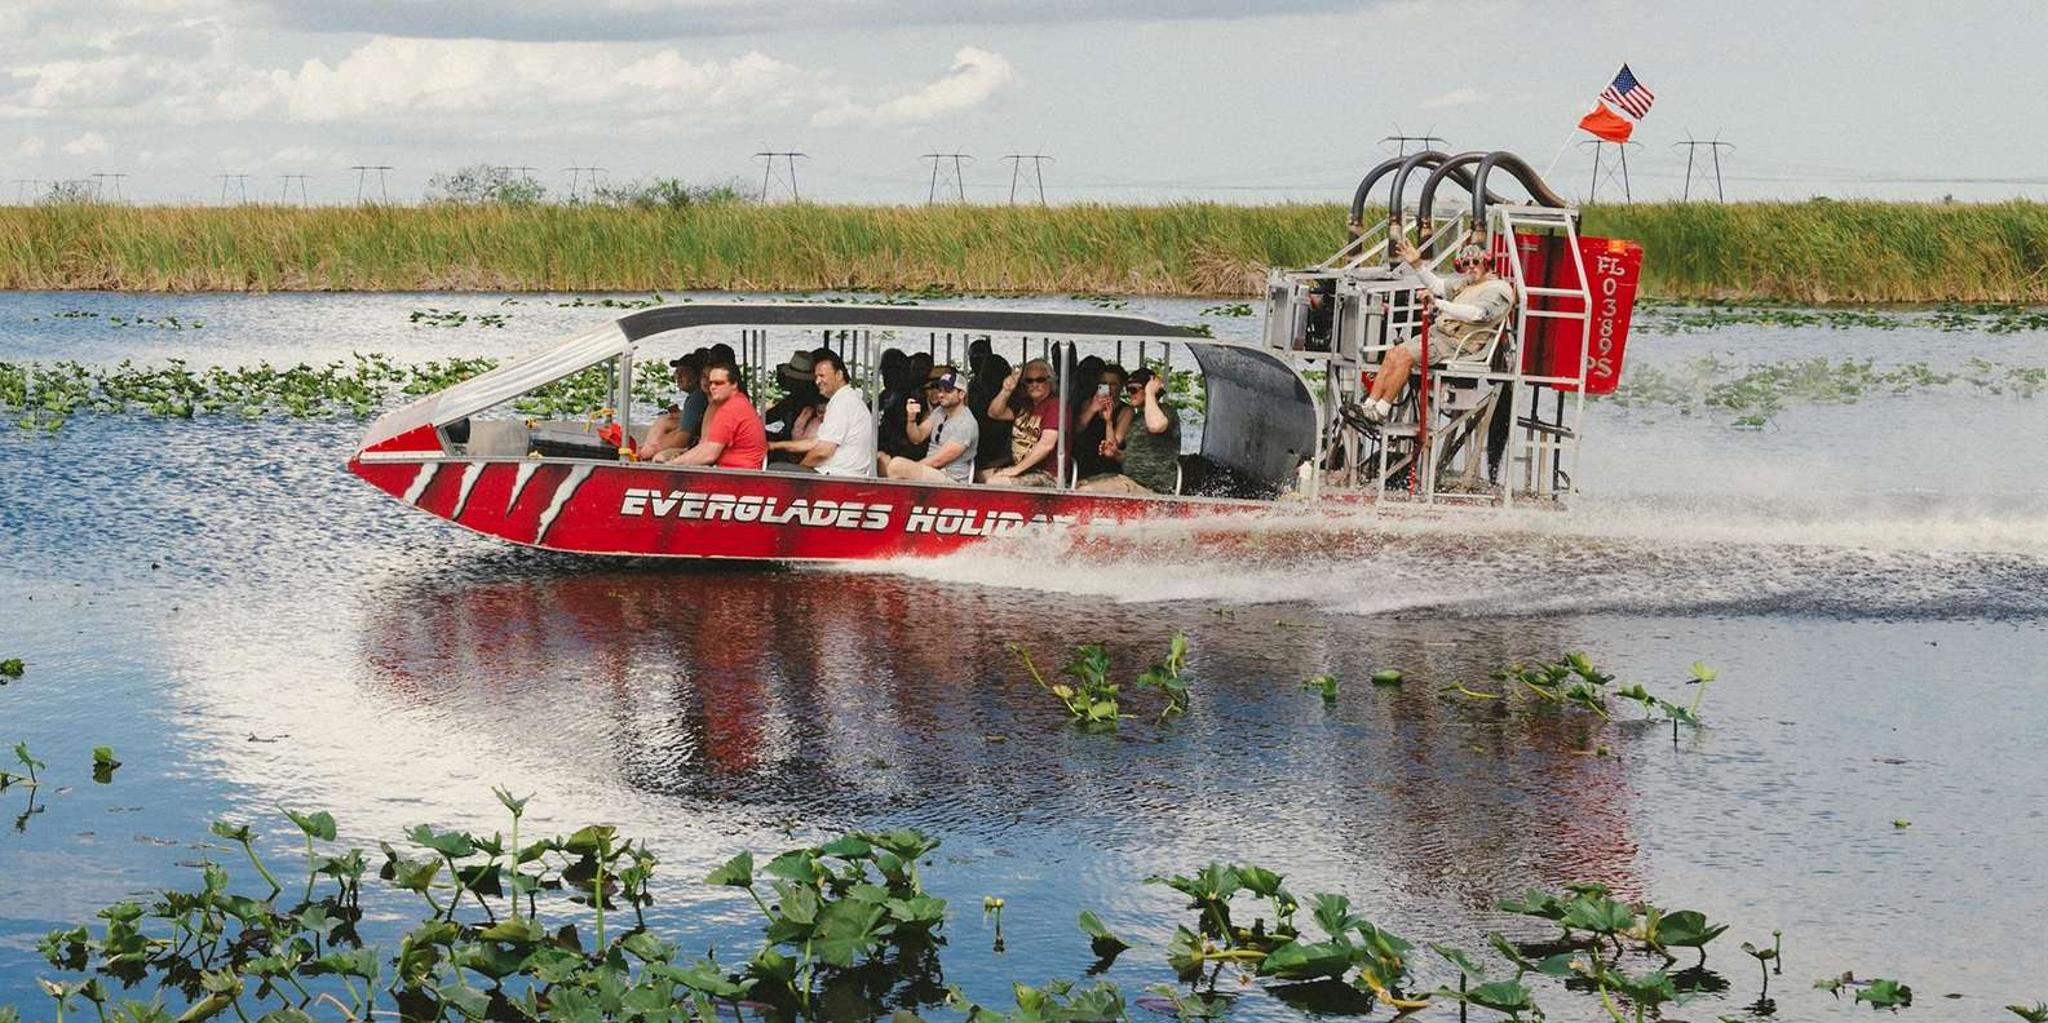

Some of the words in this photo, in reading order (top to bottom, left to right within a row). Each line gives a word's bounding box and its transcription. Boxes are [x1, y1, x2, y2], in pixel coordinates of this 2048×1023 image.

[1597, 256, 1626, 276] FL
[1597, 278, 1618, 356] 0389
[620, 488, 893, 530] EVERGLADES
